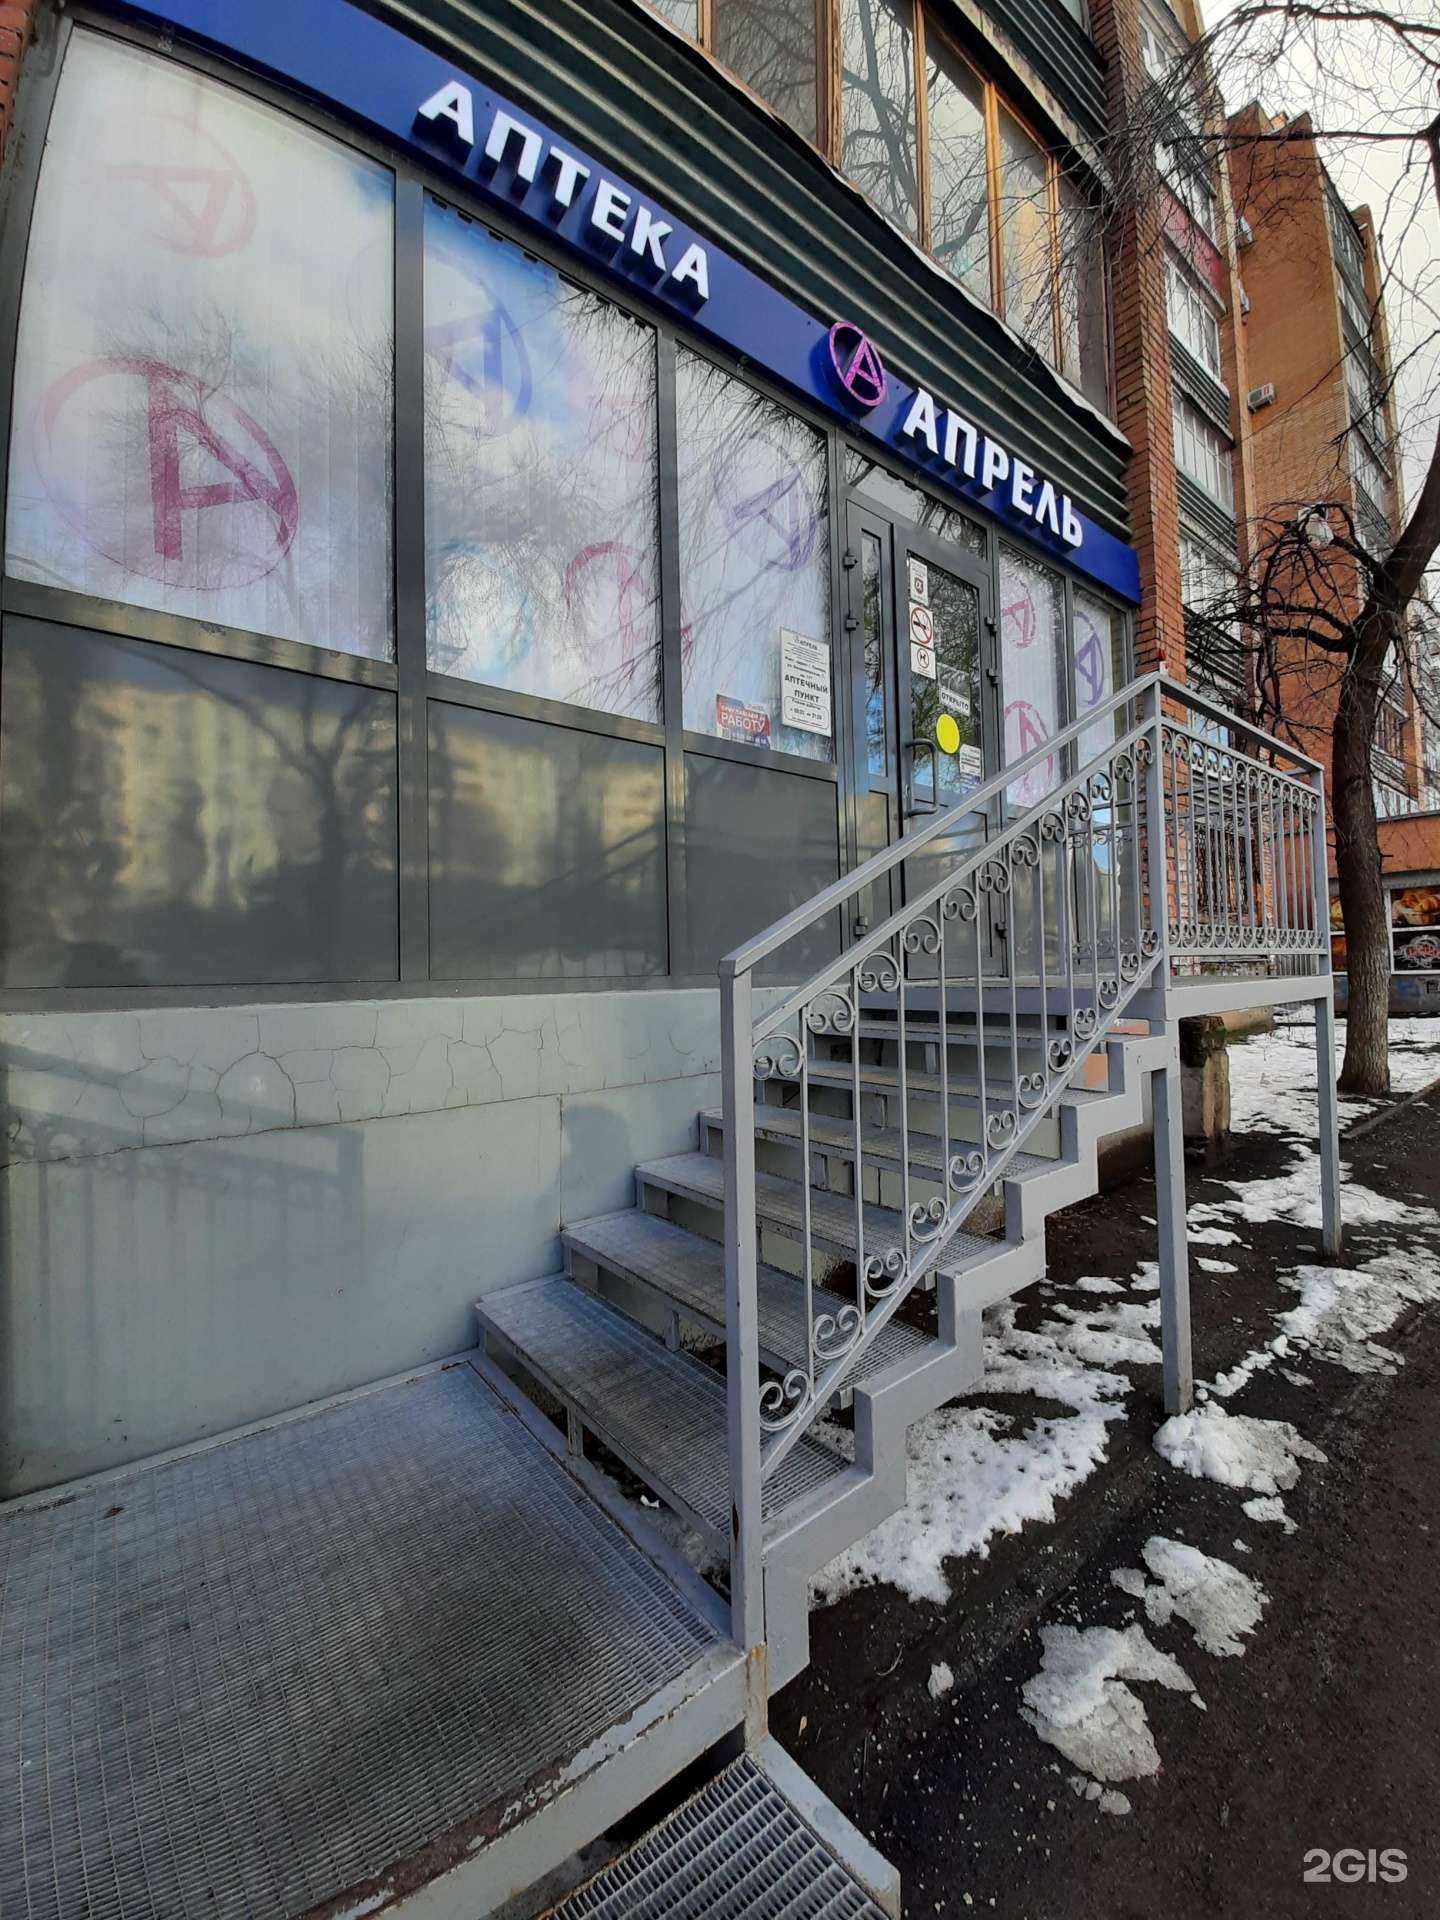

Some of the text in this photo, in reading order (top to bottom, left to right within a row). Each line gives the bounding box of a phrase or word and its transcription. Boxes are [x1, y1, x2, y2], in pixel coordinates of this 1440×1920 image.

[418, 80, 709, 300] АПТЕКА
[903, 387, 1083, 547] АПРЕЛЬ
[721, 710, 766, 733] РАБОТУ
[794, 689, 819, 703] ПУНКТ
